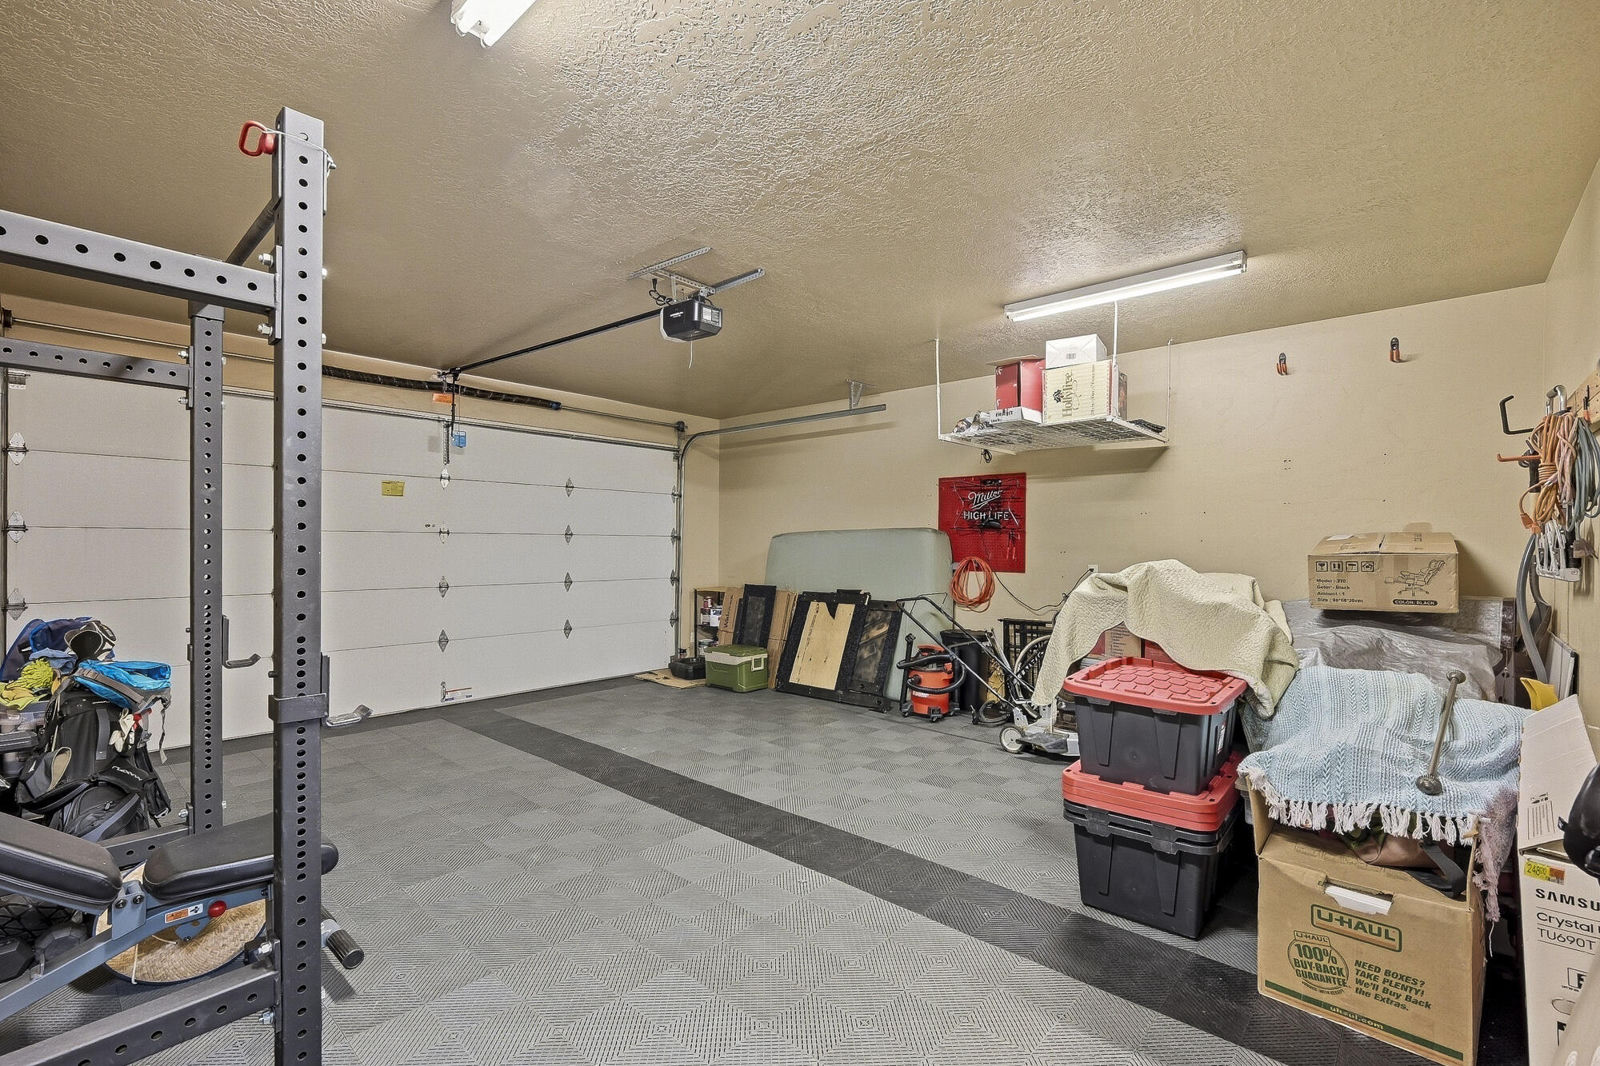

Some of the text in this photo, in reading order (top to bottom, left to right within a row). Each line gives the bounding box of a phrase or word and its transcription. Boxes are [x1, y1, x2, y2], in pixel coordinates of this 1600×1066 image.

[968, 490, 1003, 507] Miller
[963, 511, 1010, 521] HIGH LIFE
[1316, 909, 1396, 942] U-HAUL
[1536, 912, 1594, 934] Crystal
[1295, 931, 1329, 942] U-HAUL
[1537, 927, 1596, 951] TU690T
[1295, 943, 1338, 964] 100%
[1293, 957, 1346, 978] BUY-BACK
[1295, 968, 1347, 988] GUARANTEE
[1354, 960, 1425, 987] NEED BOXES?
[1355, 968, 1425, 998] TAKE PLENTY!
[1355, 977, 1380, 992] We'll
[1382, 986, 1402, 1000] Buy
[1405, 994, 1432, 1010] Back
[1355, 987, 1371, 998] the
[1374, 993, 1409, 1012] Extras.
[1330, 1006, 1384, 1030] uhaul.com
